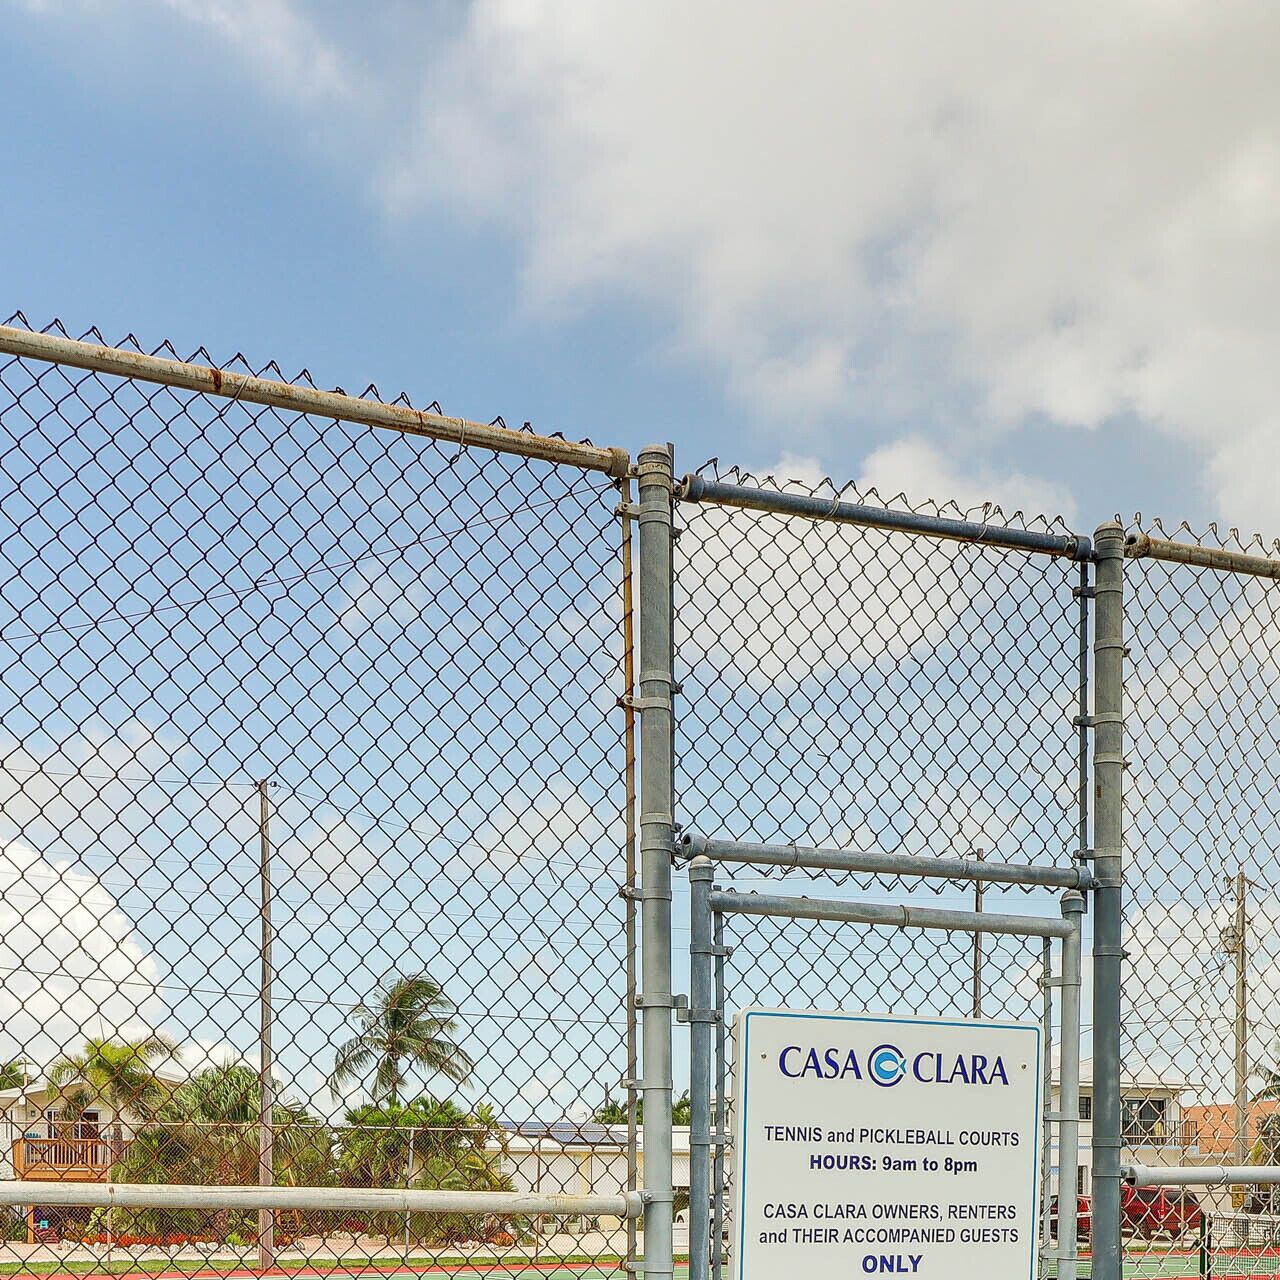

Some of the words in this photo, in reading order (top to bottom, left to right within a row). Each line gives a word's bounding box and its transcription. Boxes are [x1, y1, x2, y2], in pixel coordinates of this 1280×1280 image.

[778, 1046, 863, 1080] CASA
[912, 1051, 1010, 1086] CLARA
[764, 1125, 823, 1143] TENNIS
[827, 1128, 855, 1144] and
[859, 1128, 955, 1146] PICKLEBALL
[958, 1131, 1020, 1147] COURTS
[809, 1154, 877, 1171] HOURS:
[881, 1155, 917, 1172] 9am
[922, 1156, 939, 1172] to
[943, 1156, 978, 1176] 8pm
[763, 1203, 809, 1219] CASA
[813, 1203, 868, 1220] CLARA
[871, 1203, 944, 1222] OWNERS,
[947, 1204, 1017, 1220] RENTERS
[759, 1228, 788, 1244] and
[792, 1228, 840, 1244] THEIR
[842, 1228, 956, 1244] ACCOMPANIED
[959, 1228, 1019, 1243] GUESTS
[861, 1254, 924, 1274] ONLY
